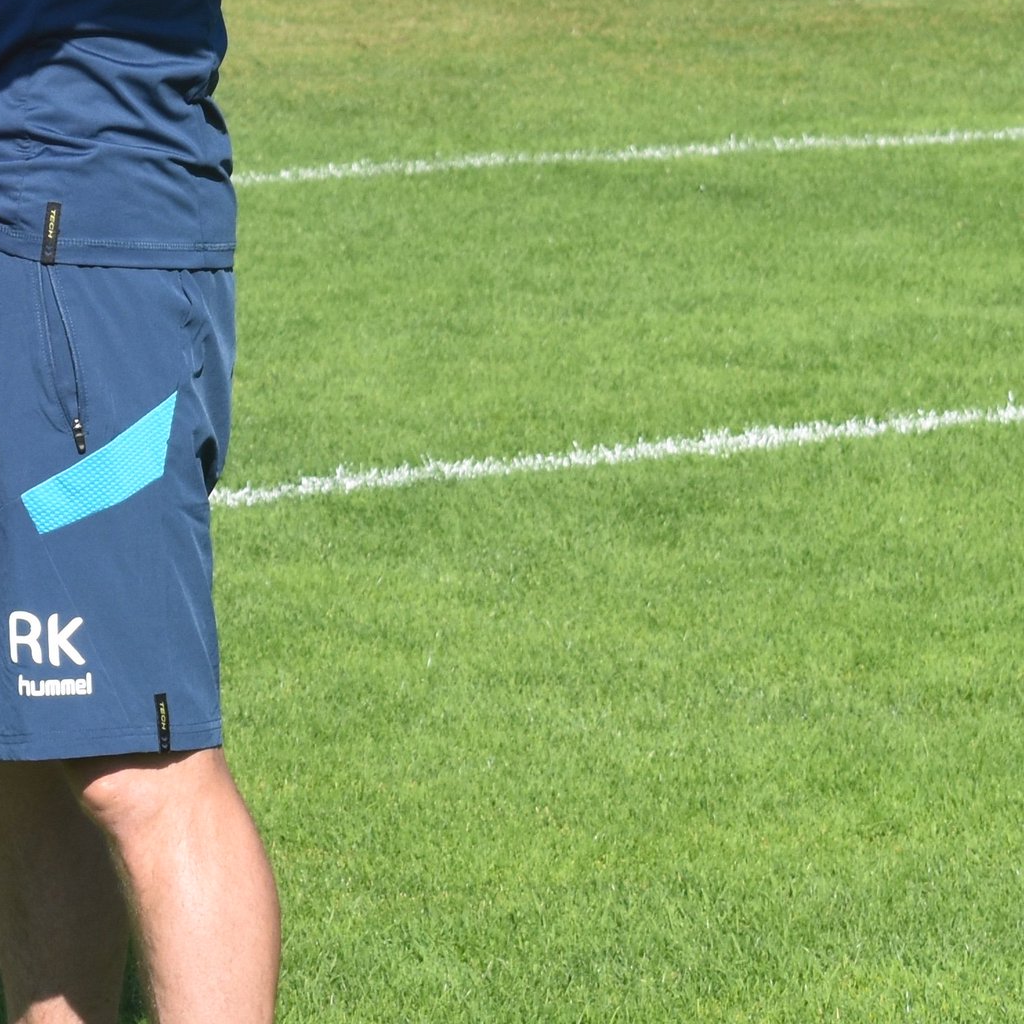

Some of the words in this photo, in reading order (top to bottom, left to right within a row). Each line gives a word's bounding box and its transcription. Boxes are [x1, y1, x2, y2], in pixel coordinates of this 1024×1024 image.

[47, 209, 57, 239] TECH
[8, 610, 86, 667] RK
[18, 671, 93, 697] hummel
[159, 701, 167, 731] TECH
